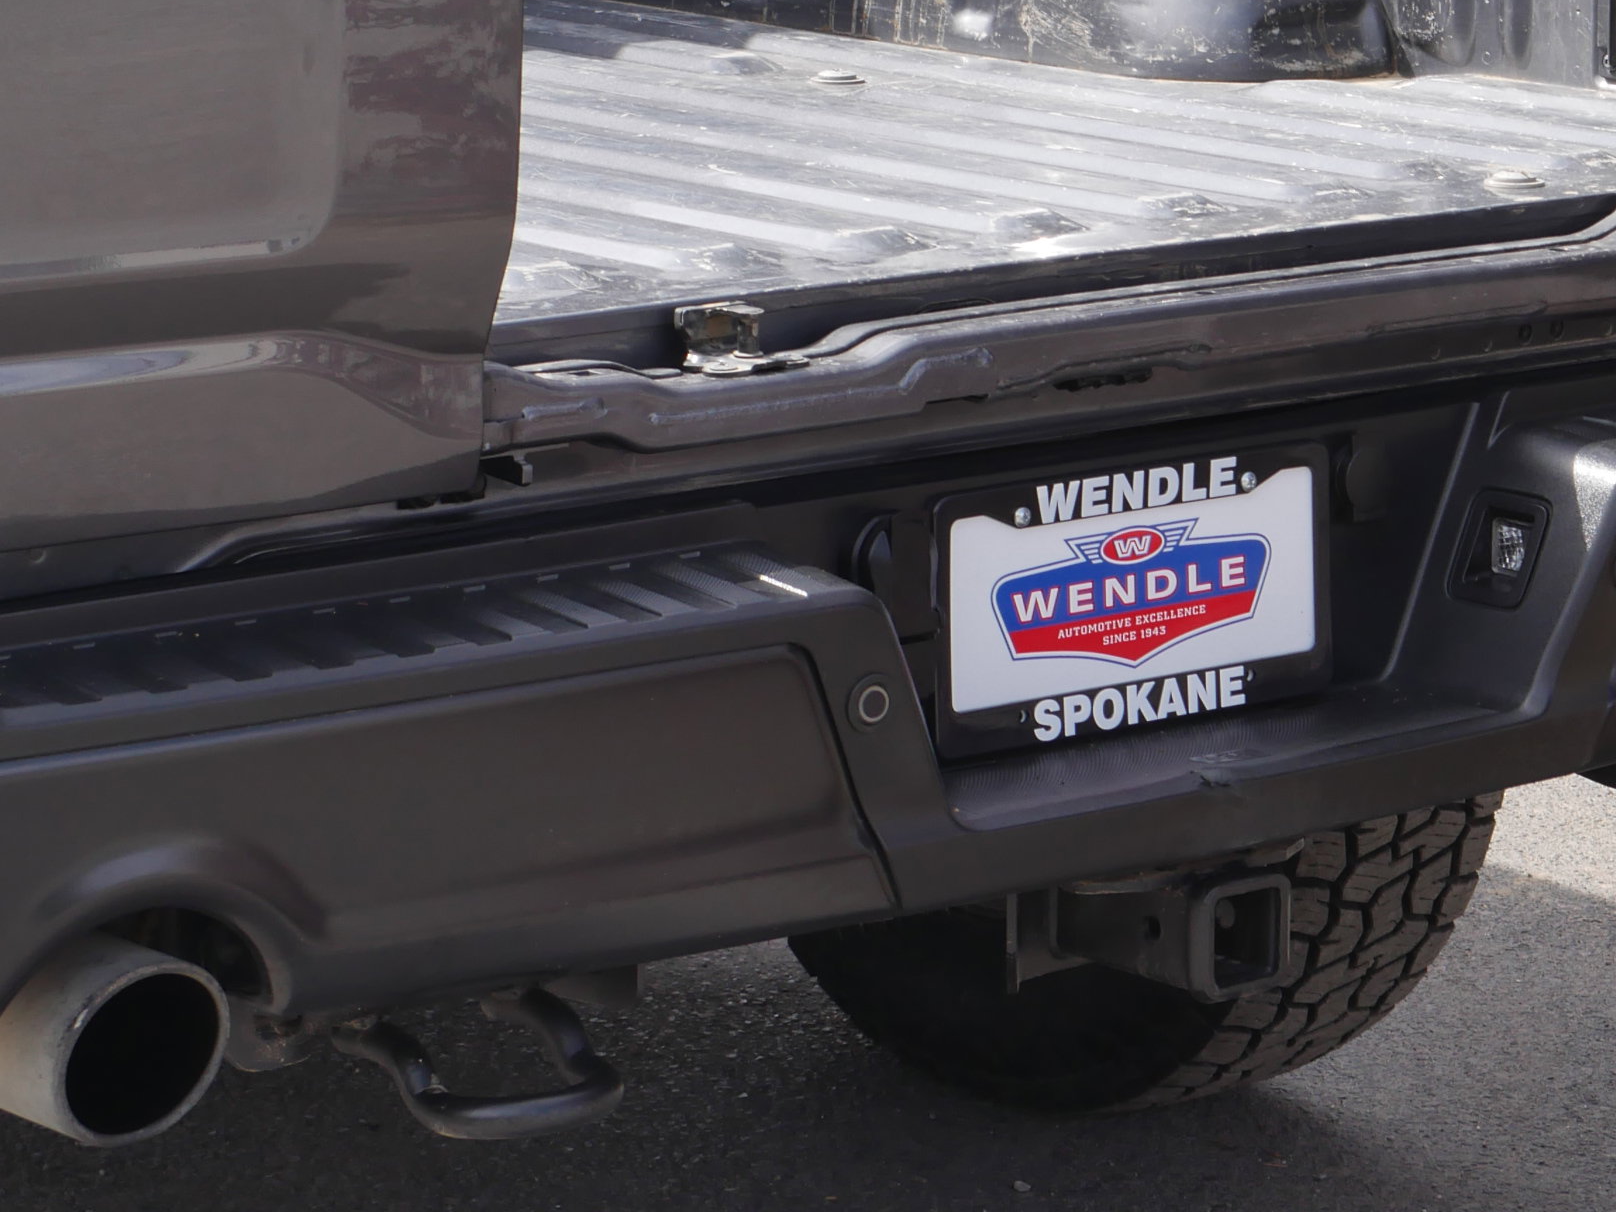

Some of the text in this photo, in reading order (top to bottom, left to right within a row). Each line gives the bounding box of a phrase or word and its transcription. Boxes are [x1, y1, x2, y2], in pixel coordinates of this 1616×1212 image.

[1036, 456, 1237, 525] WENDLE
[1114, 535, 1151, 556] W
[1012, 556, 1246, 624] WENDLE
[1058, 604, 1206, 640] AUTOMOTIVE EXCELLENCE
[1102, 625, 1167, 646] SINCE 1943
[1033, 665, 1246, 742] SPOKANE
